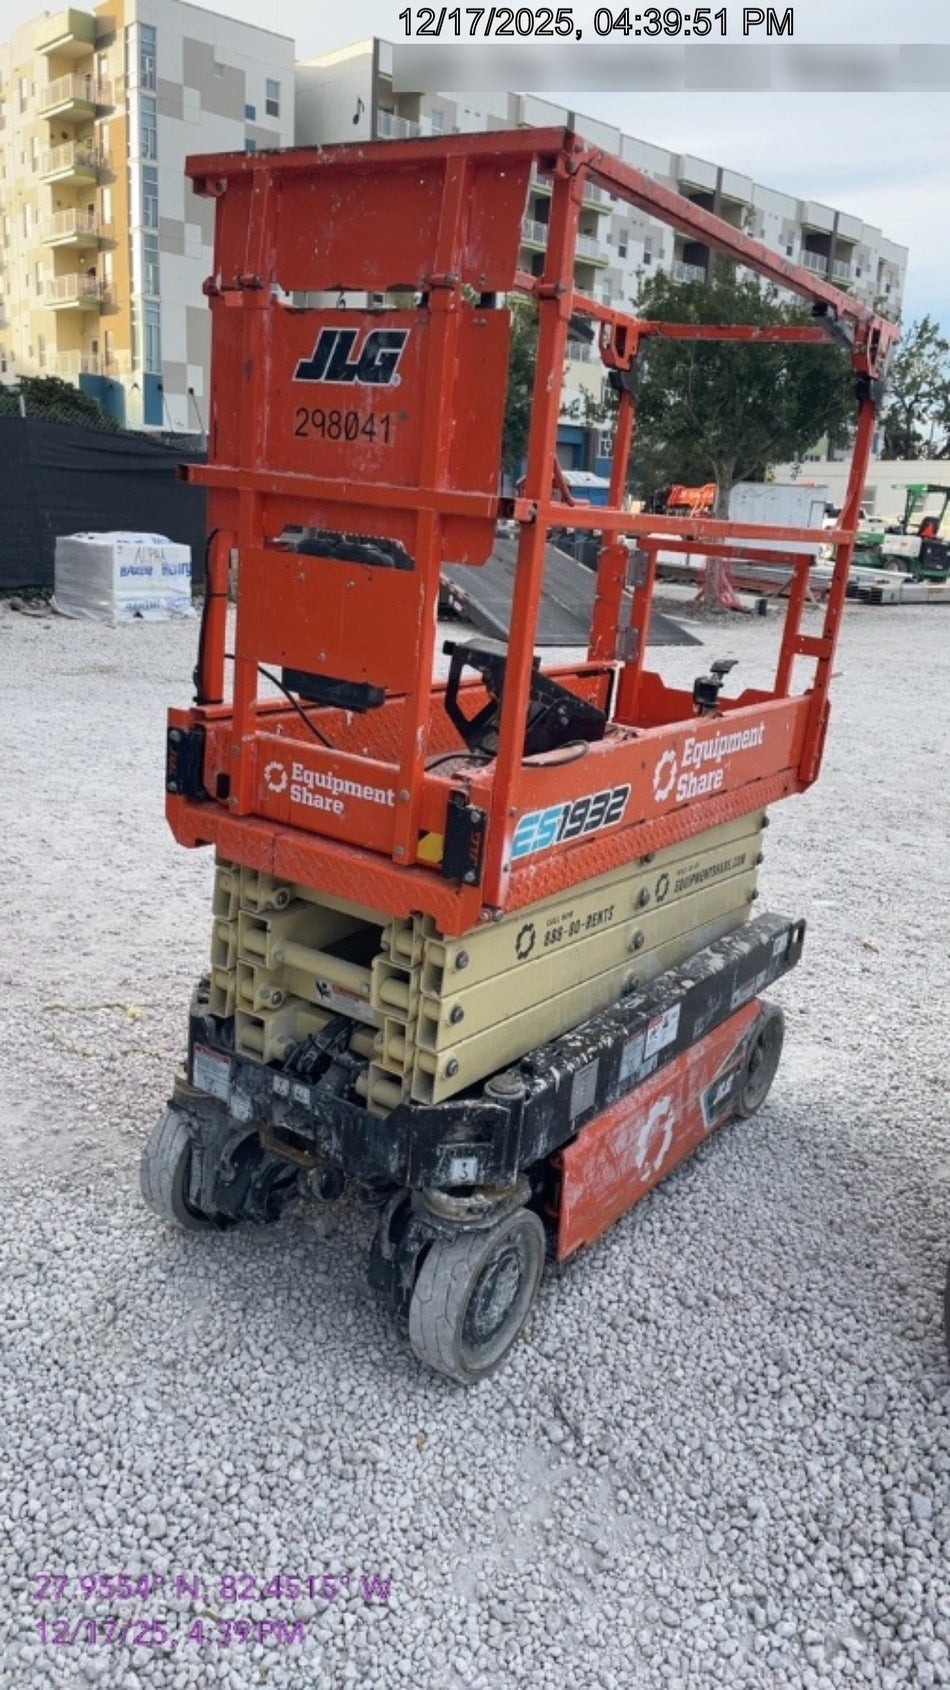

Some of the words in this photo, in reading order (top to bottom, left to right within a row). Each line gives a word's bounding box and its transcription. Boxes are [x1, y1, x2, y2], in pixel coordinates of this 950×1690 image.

[292, 327, 411, 386] JLG
[294, 407, 392, 444] 298041
[681, 721, 766, 769] Equipment
[290, 786, 345, 815] Share
[291, 761, 395, 807] Equipment
[675, 768, 724, 802] Share
[512, 784, 631, 859] ES1932
